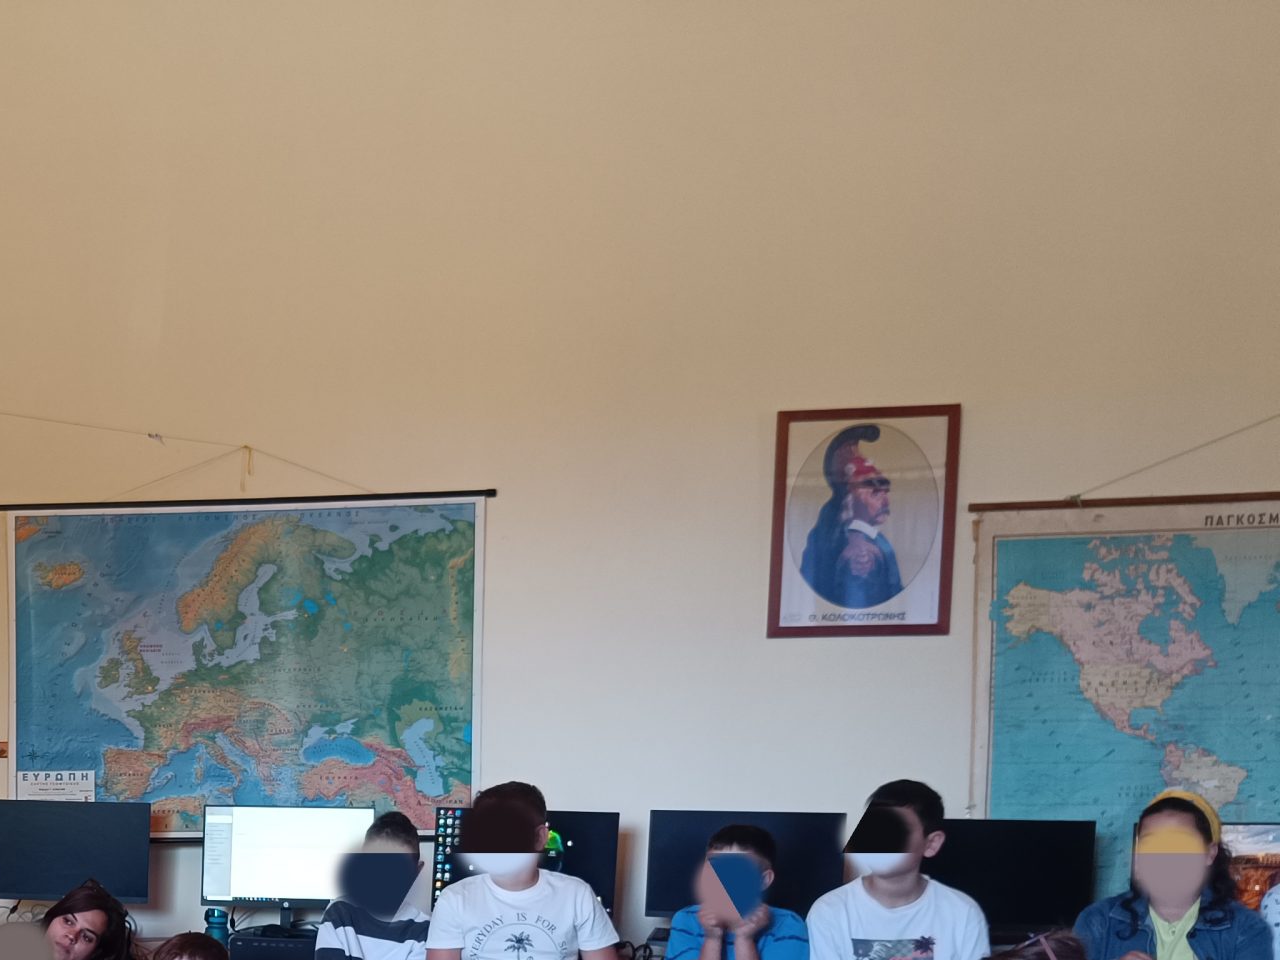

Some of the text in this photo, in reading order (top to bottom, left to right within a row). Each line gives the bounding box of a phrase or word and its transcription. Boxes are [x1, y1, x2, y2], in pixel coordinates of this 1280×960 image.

[22, 772, 89, 782] ΕΥΡΩΠΗ
[516, 912, 527, 922] IS
[535, 915, 557, 935] FOR
